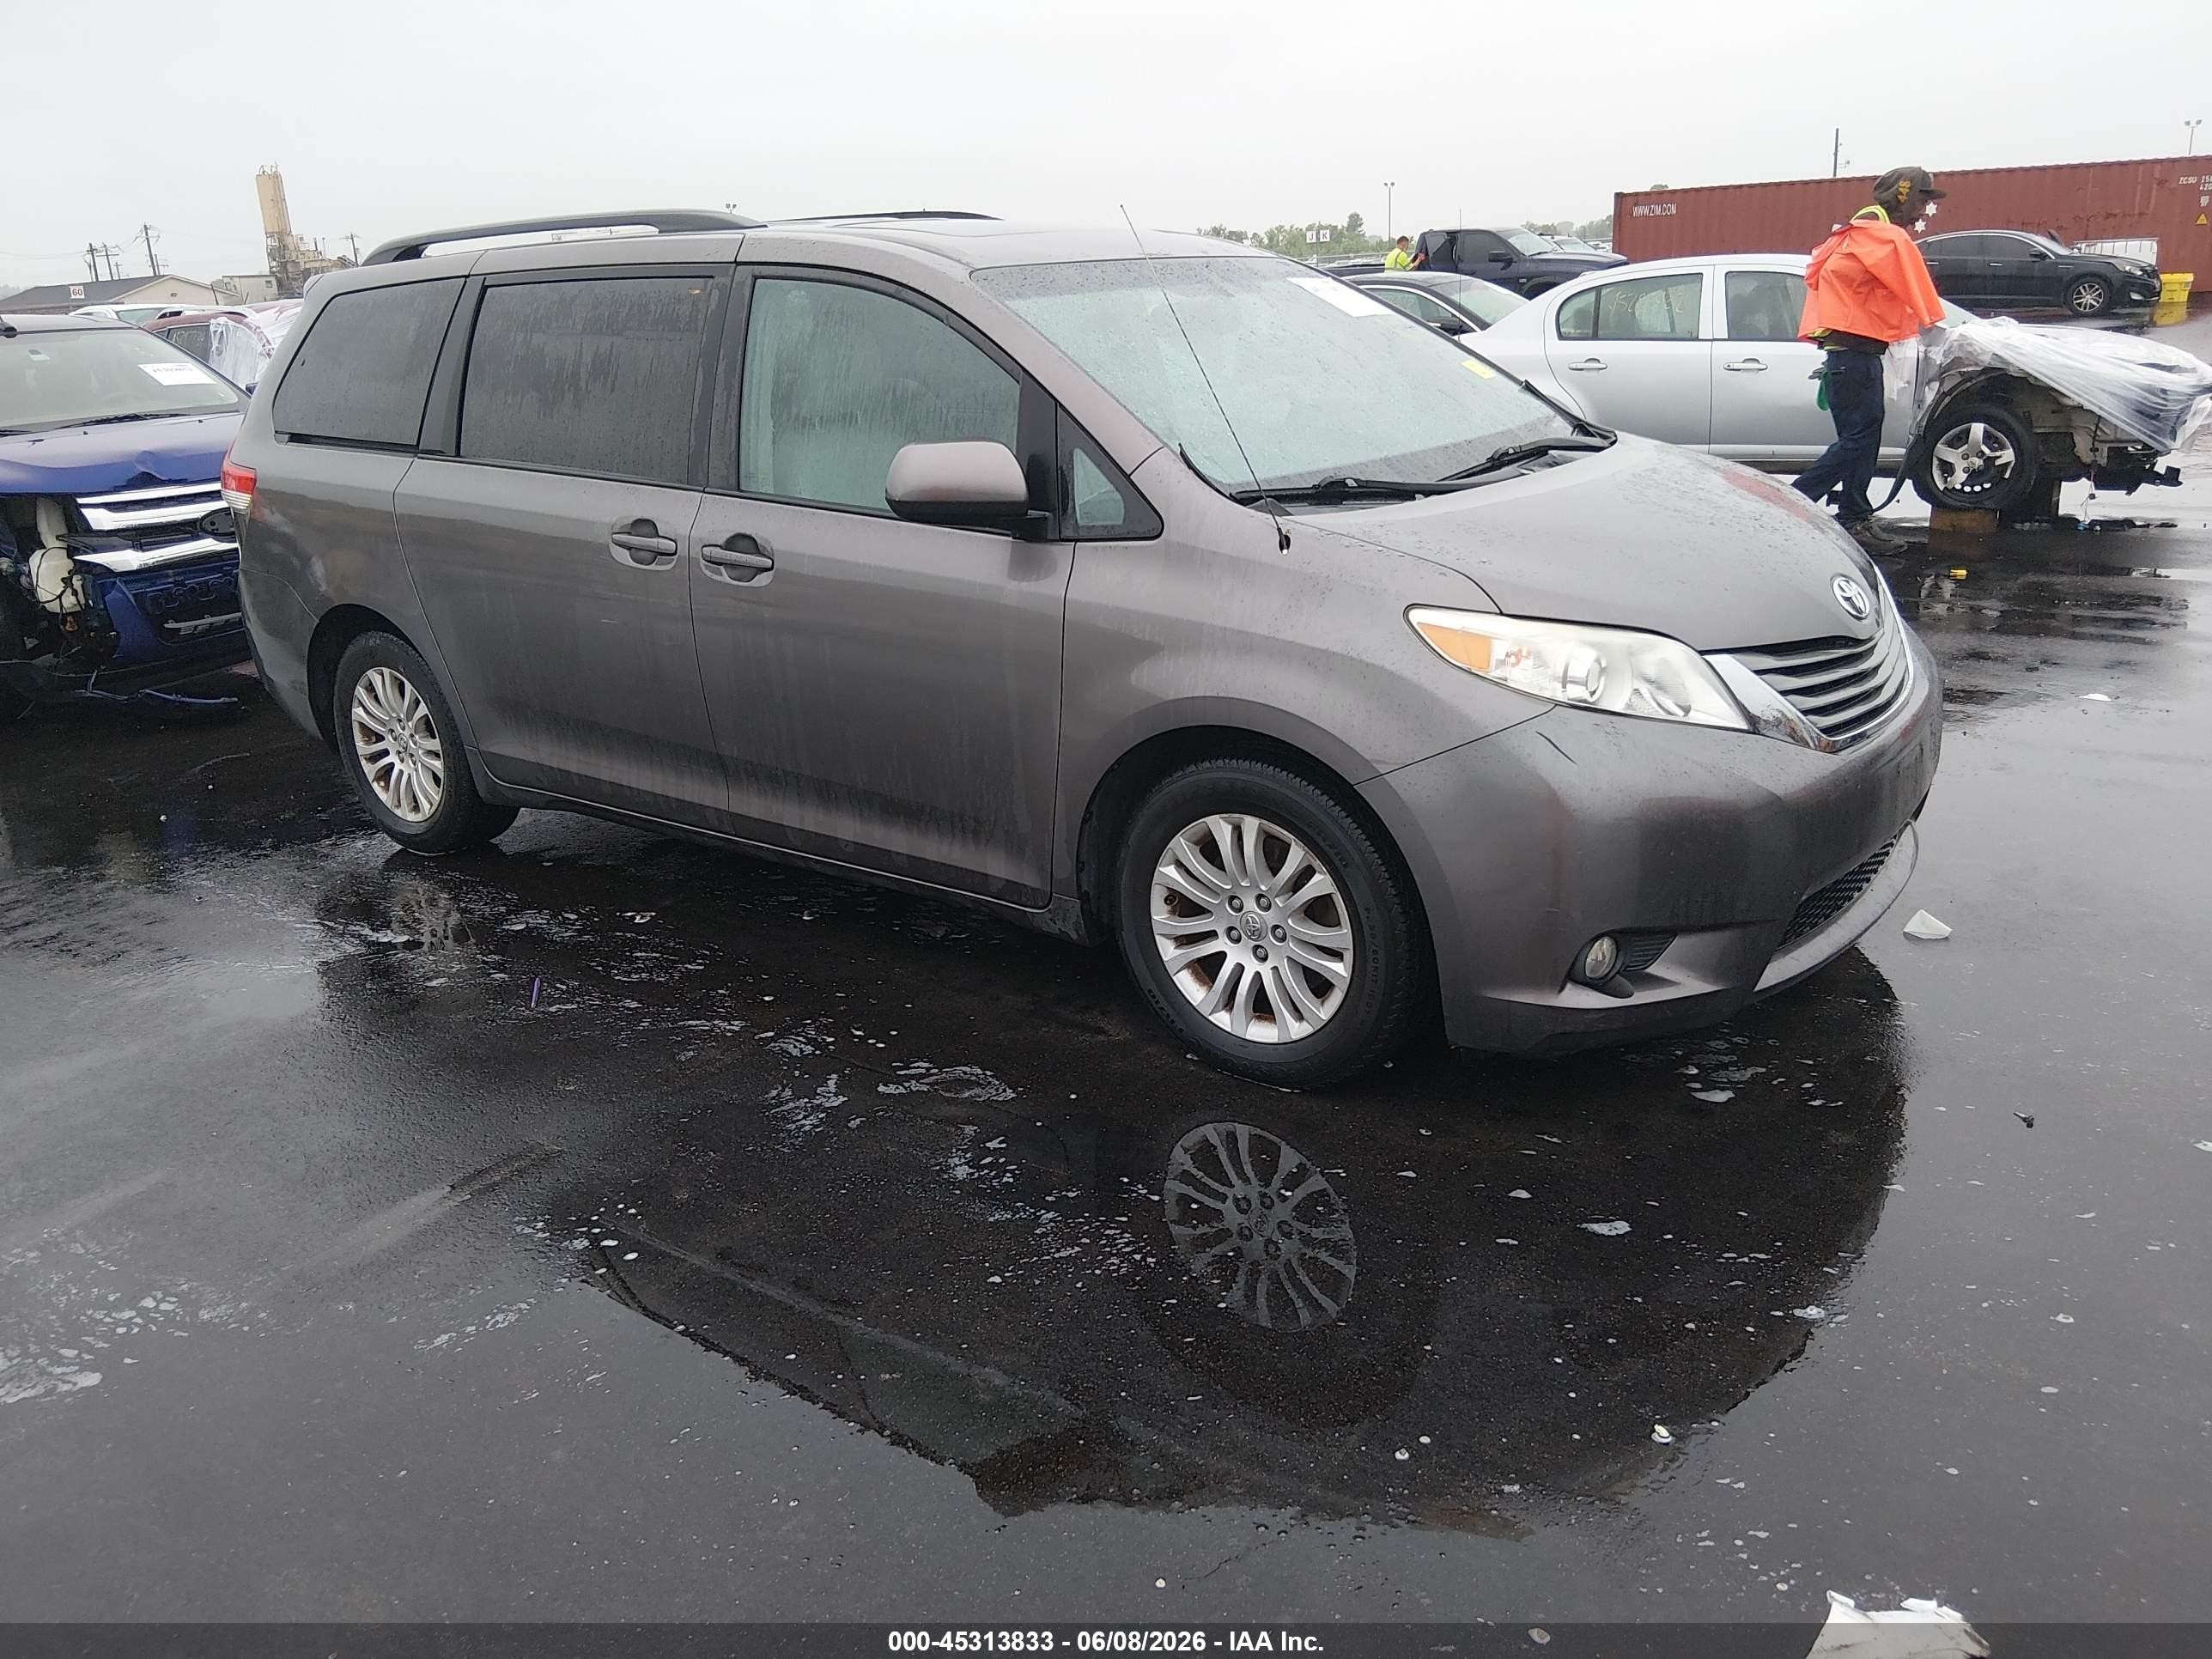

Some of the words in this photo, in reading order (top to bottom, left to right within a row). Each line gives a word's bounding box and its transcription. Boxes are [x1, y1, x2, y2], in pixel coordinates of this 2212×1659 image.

[2178, 176, 2197, 185] ZCSU
[1632, 203, 1677, 217] WWW.ZIM.COM
[72, 288, 83, 296] 60
